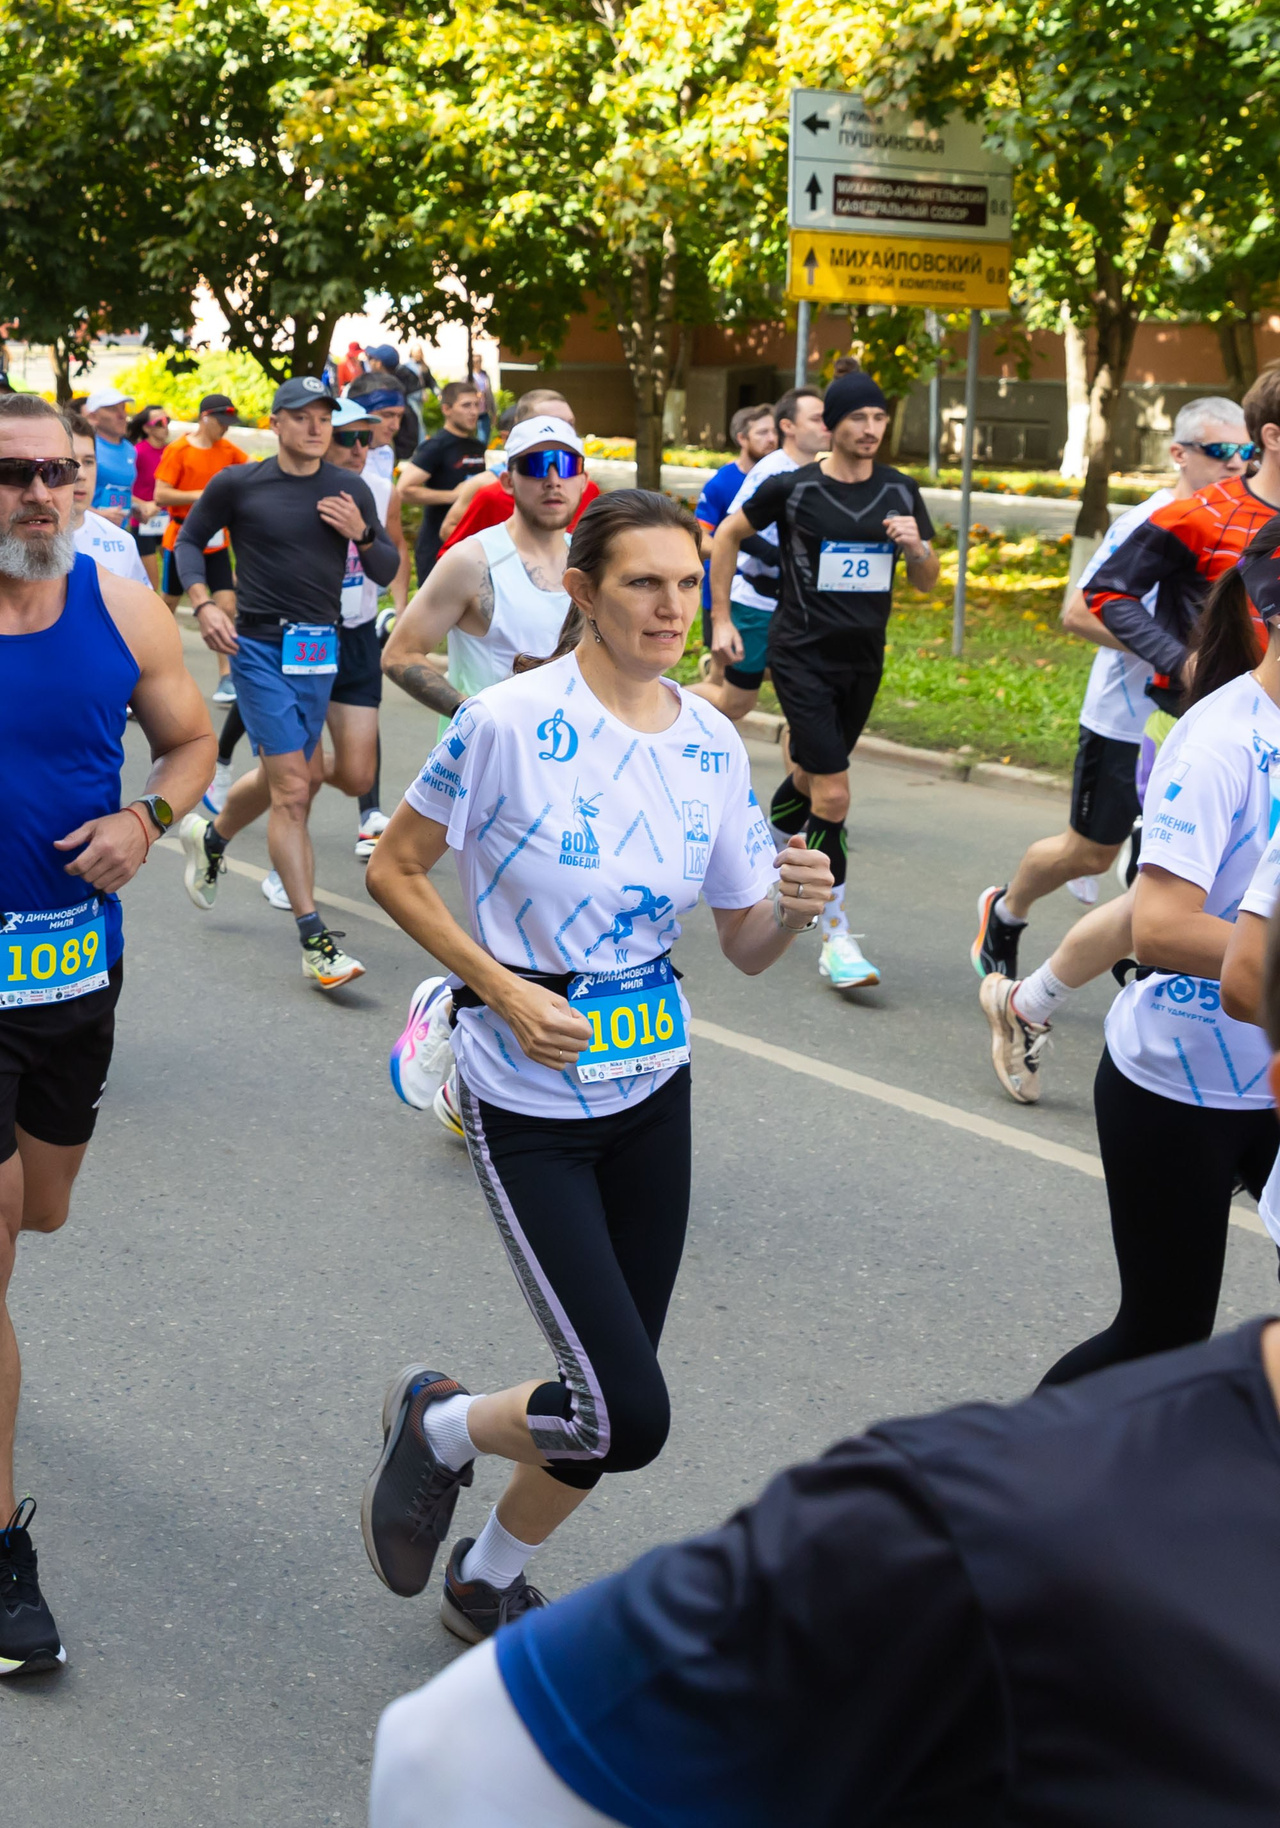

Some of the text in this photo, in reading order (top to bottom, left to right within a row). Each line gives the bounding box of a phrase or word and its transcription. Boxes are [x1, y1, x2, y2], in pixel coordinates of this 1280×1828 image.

[930, 204, 970, 221] СОБОР
[829, 246, 983, 275] МИХАЙЛОВСКИЙ
[102, 540, 125, 552] ВТБ
[842, 559, 869, 578] 28
[295, 642, 327, 661] 326
[561, 831, 585, 853] 80
[558, 853, 601, 869] ПОБЕДА!
[25, 903, 88, 922] ДИНАМОВСКАЯ
[49, 918, 75, 930] МИЛЯ
[7, 930, 99, 982] 1089
[596, 964, 655, 984] ДИНАМОВСКАЯ
[620, 978, 644, 991] МИЛЯ
[1167, 1006, 1217, 1025] УДМУРТИИ
[587, 998, 675, 1054] 1016
